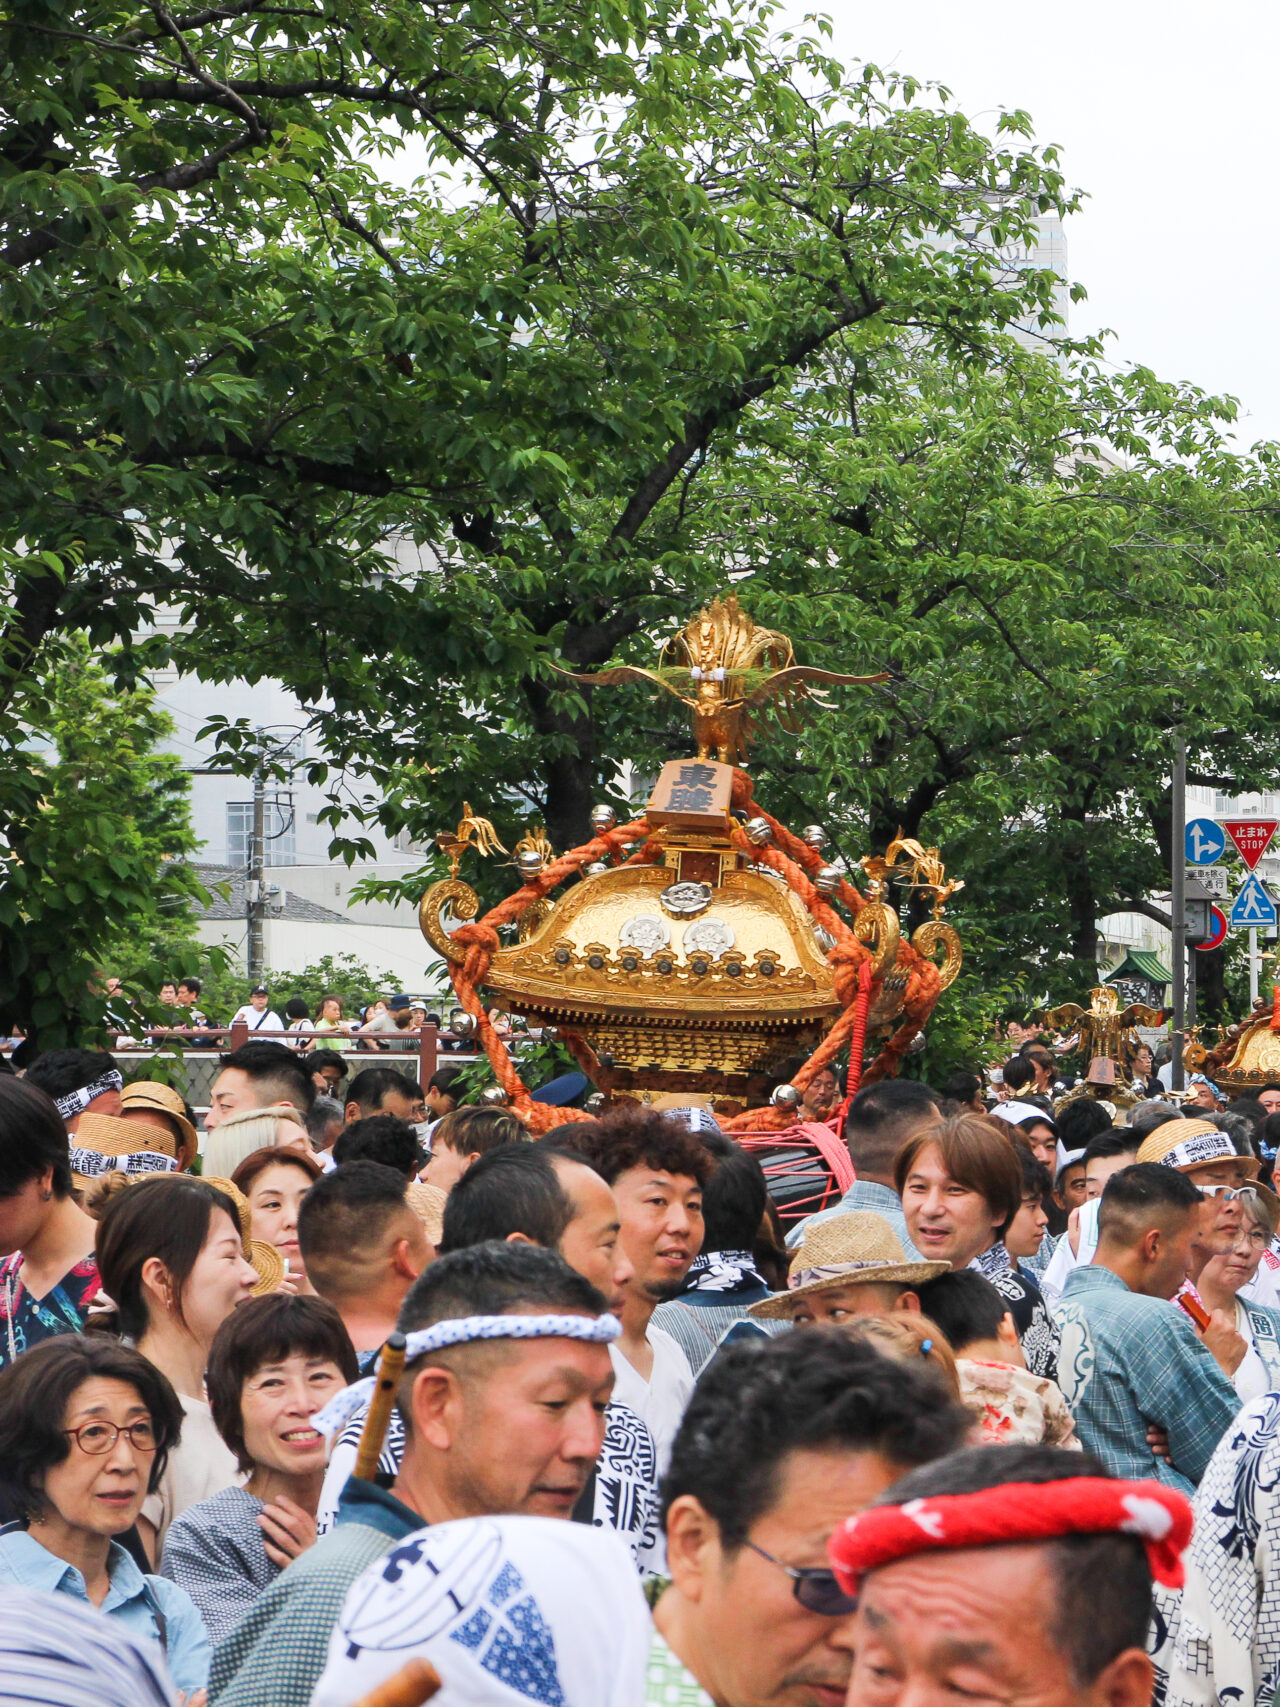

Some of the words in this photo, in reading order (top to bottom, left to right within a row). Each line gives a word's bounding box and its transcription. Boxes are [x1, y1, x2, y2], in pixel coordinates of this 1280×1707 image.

[1235, 826, 1268, 838] 止まれ
[1241, 840, 1264, 849] STOP
[1202, 879, 1224, 889] 通行
